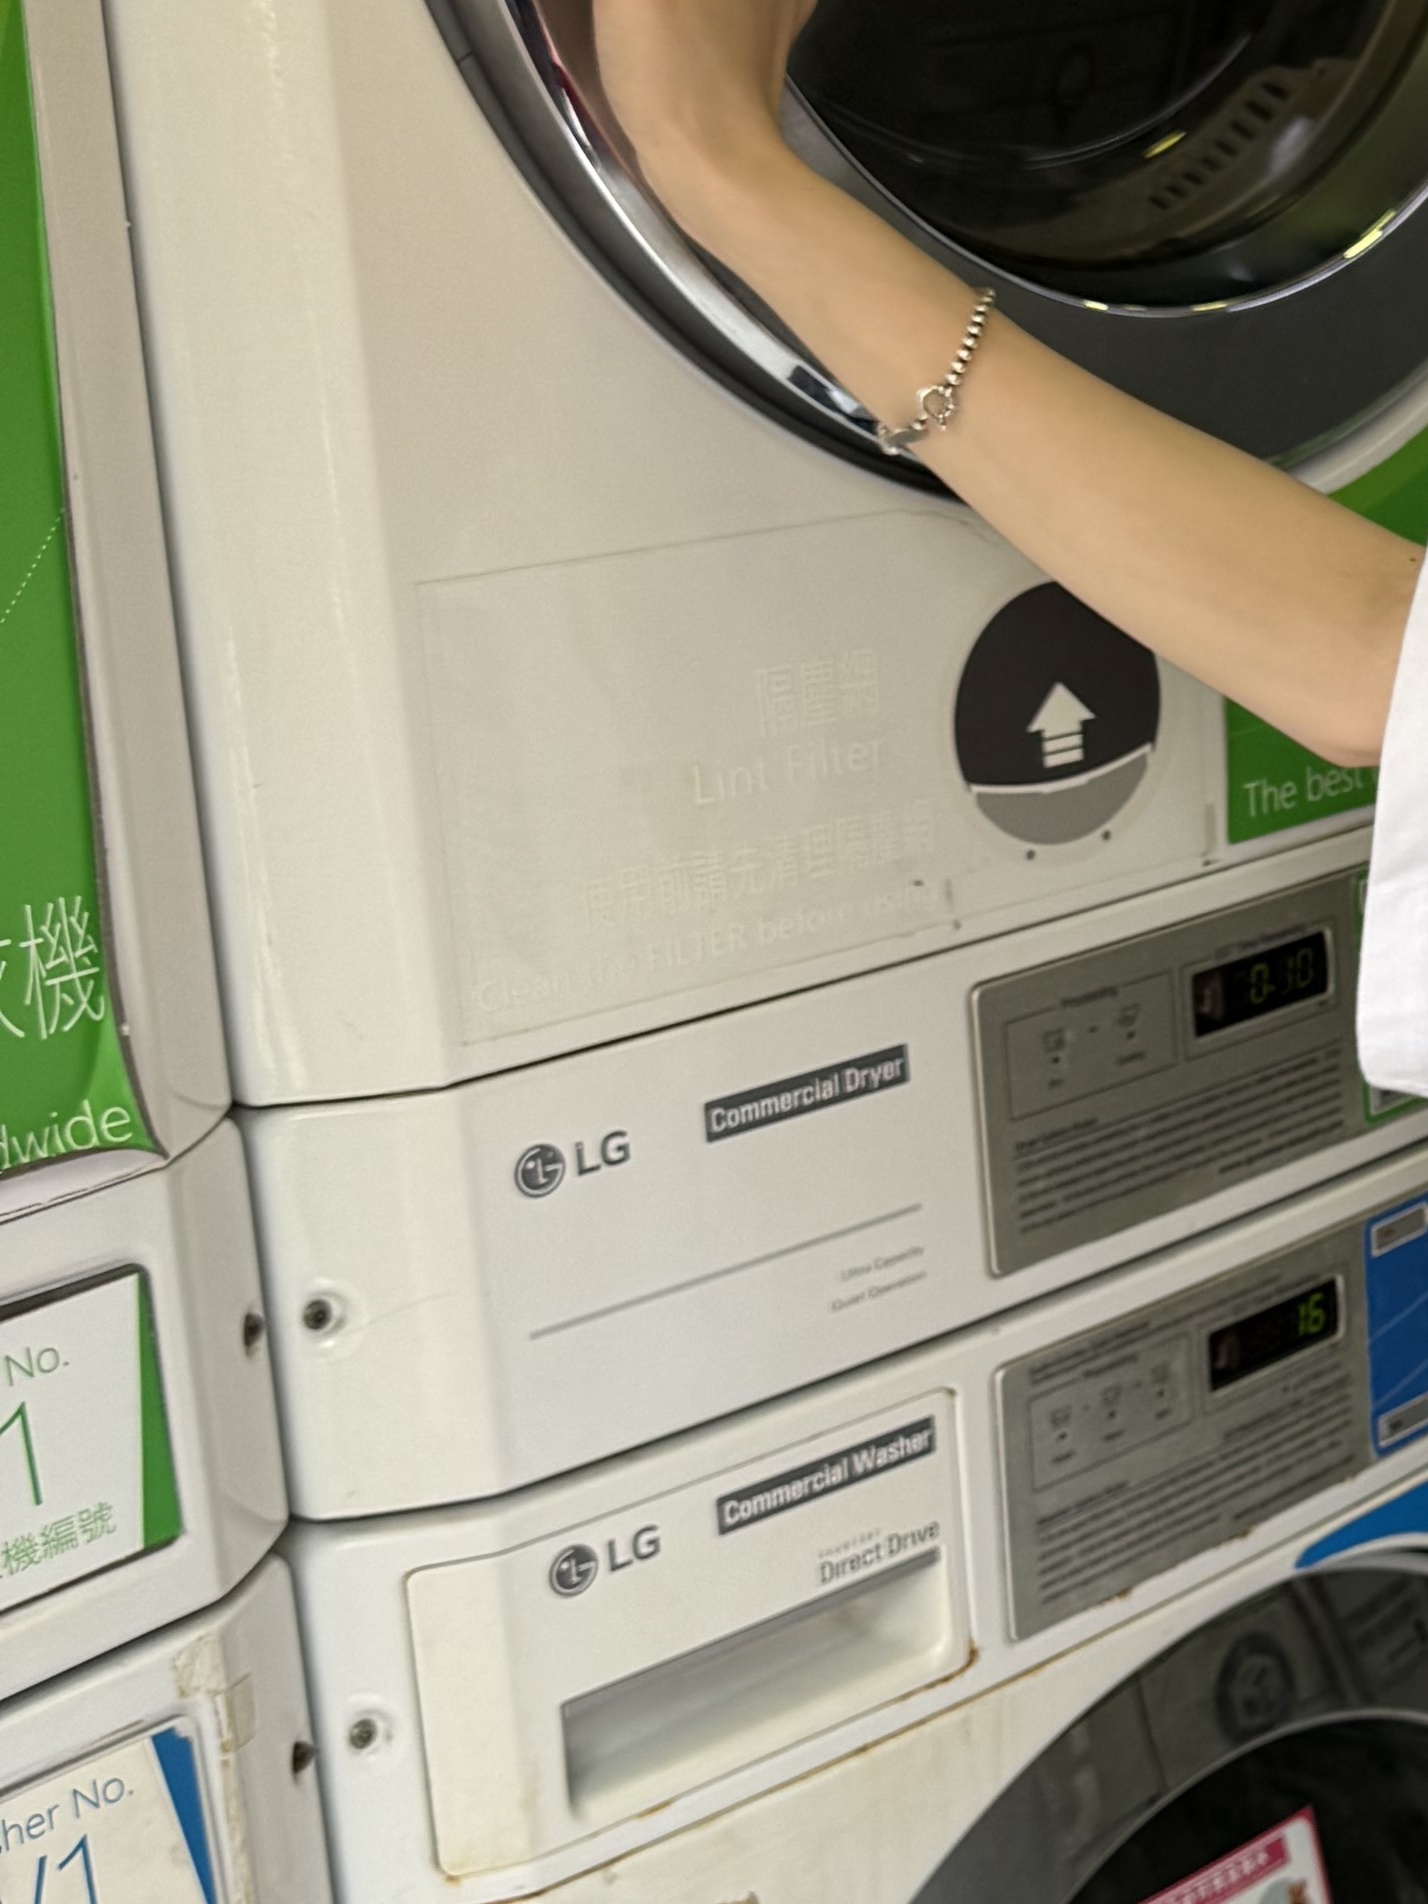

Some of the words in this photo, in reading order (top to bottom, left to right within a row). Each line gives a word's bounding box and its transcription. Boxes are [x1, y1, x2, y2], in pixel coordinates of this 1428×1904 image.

[693, 758, 769, 806] Lint
[786, 737, 885, 784] Filter
[1243, 779, 1299, 818] The
[1306, 764, 1363, 803] best
[476, 971, 573, 1014] Clean
[586, 952, 634, 988] the
[647, 921, 748, 972] FILTER
[756, 904, 850, 947] before
[709, 1072, 842, 1135] Commercial
[844, 1056, 906, 1095] Dryer
[575, 1130, 630, 1177] LG
[4, 1347, 70, 1387] No.
[0, 1400, 43, 1506] 1
[723, 1457, 851, 1528] Commercial
[852, 1424, 934, 1476] Washer
[607, 1524, 662, 1575] LG
[819, 1545, 885, 1587] Direct
[0, 1802, 60, 1854] her
[72, 1777, 134, 1819] No.
